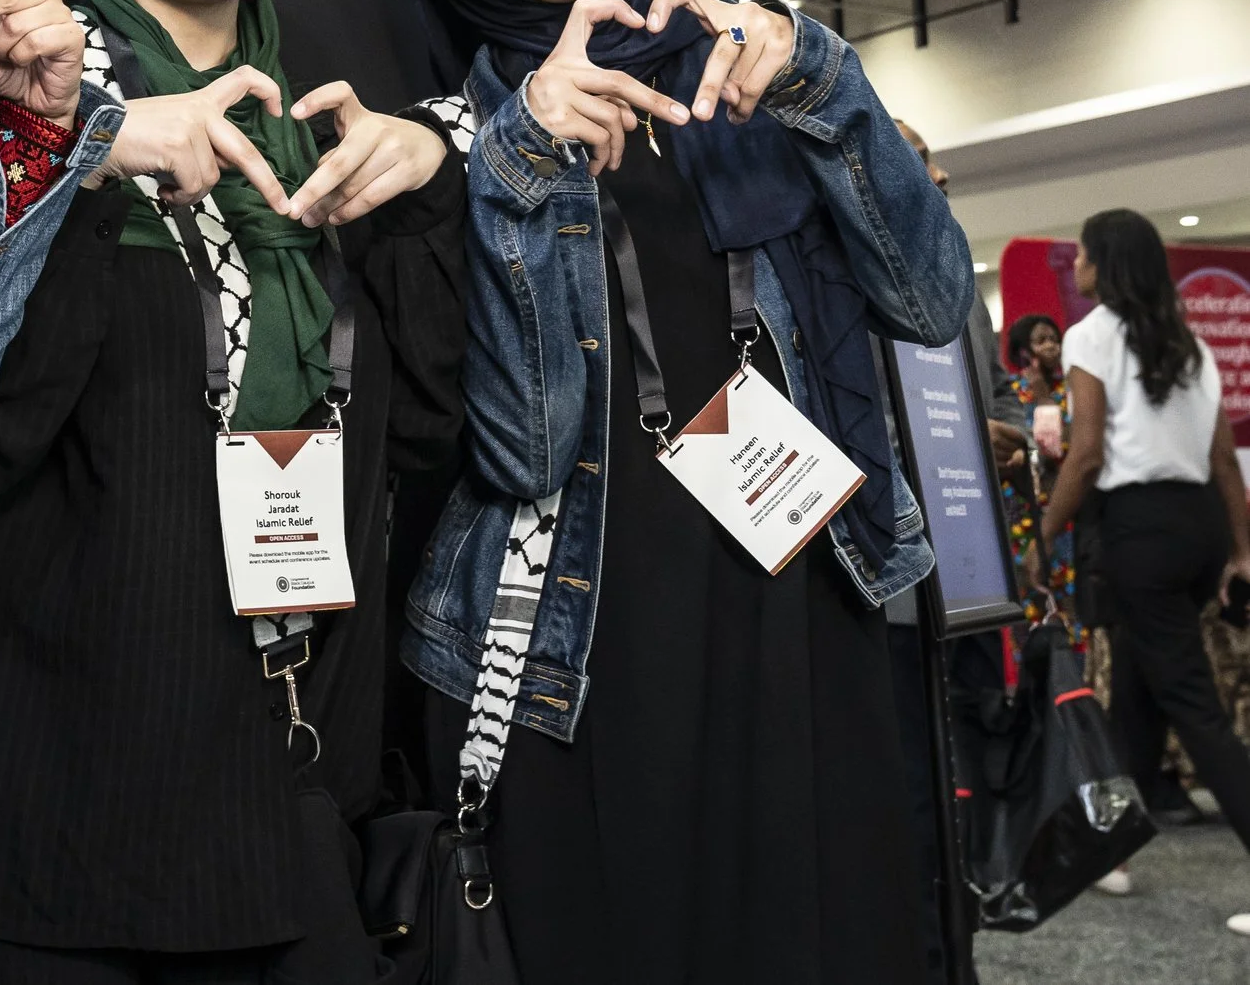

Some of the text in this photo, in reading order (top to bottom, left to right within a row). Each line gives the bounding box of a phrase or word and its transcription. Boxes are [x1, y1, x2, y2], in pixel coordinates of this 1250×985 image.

[730, 436, 758, 464] Haneen
[741, 447, 766, 472] Jubran
[738, 442, 785, 492] Islamic Relief
[758, 463, 787, 492] OPEN ACCESS
[265, 490, 301, 499] Shorouk
[268, 505, 299, 514] Jaradat
[256, 517, 313, 528] Islamic Relief
